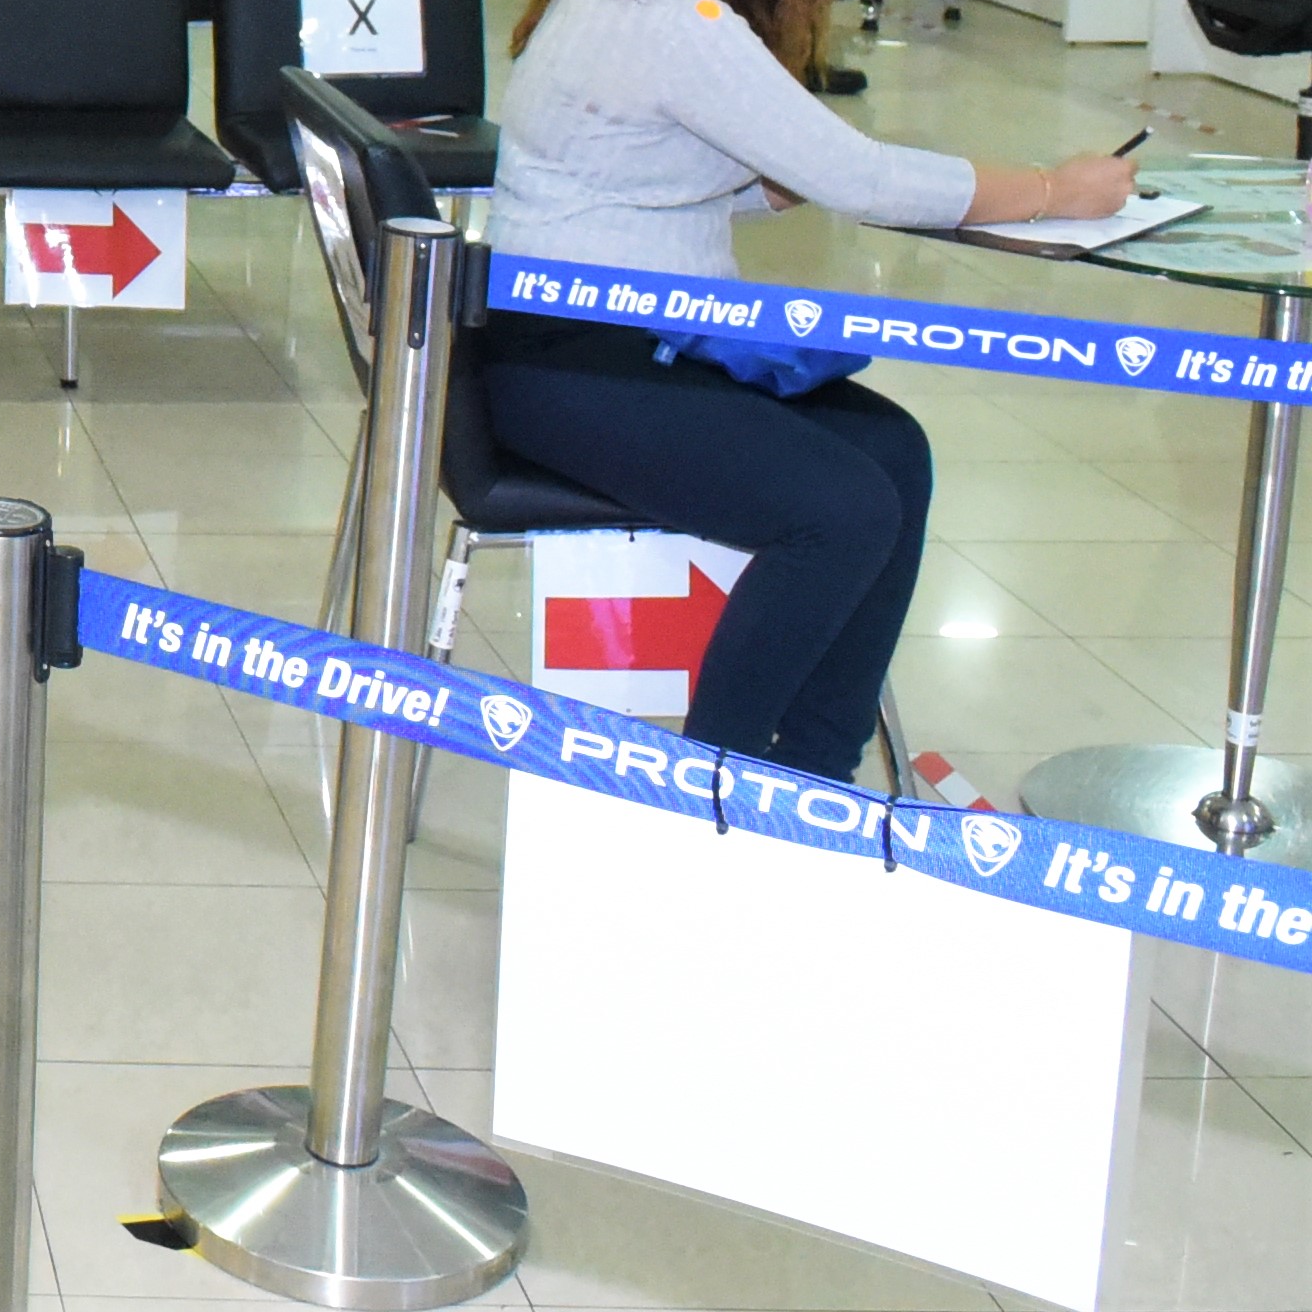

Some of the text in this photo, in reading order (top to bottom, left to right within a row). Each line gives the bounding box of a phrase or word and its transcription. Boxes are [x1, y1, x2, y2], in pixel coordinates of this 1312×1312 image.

[512, 271, 762, 328] It's in the Drive!
[843, 313, 1097, 368] PROTON
[1176, 348, 1234, 383] It's
[1241, 355, 1277, 388] in
[121, 602, 451, 727] It's in the Drive!
[561, 727, 931, 853] PROTON
[1043, 842, 1312, 946] It's in the
